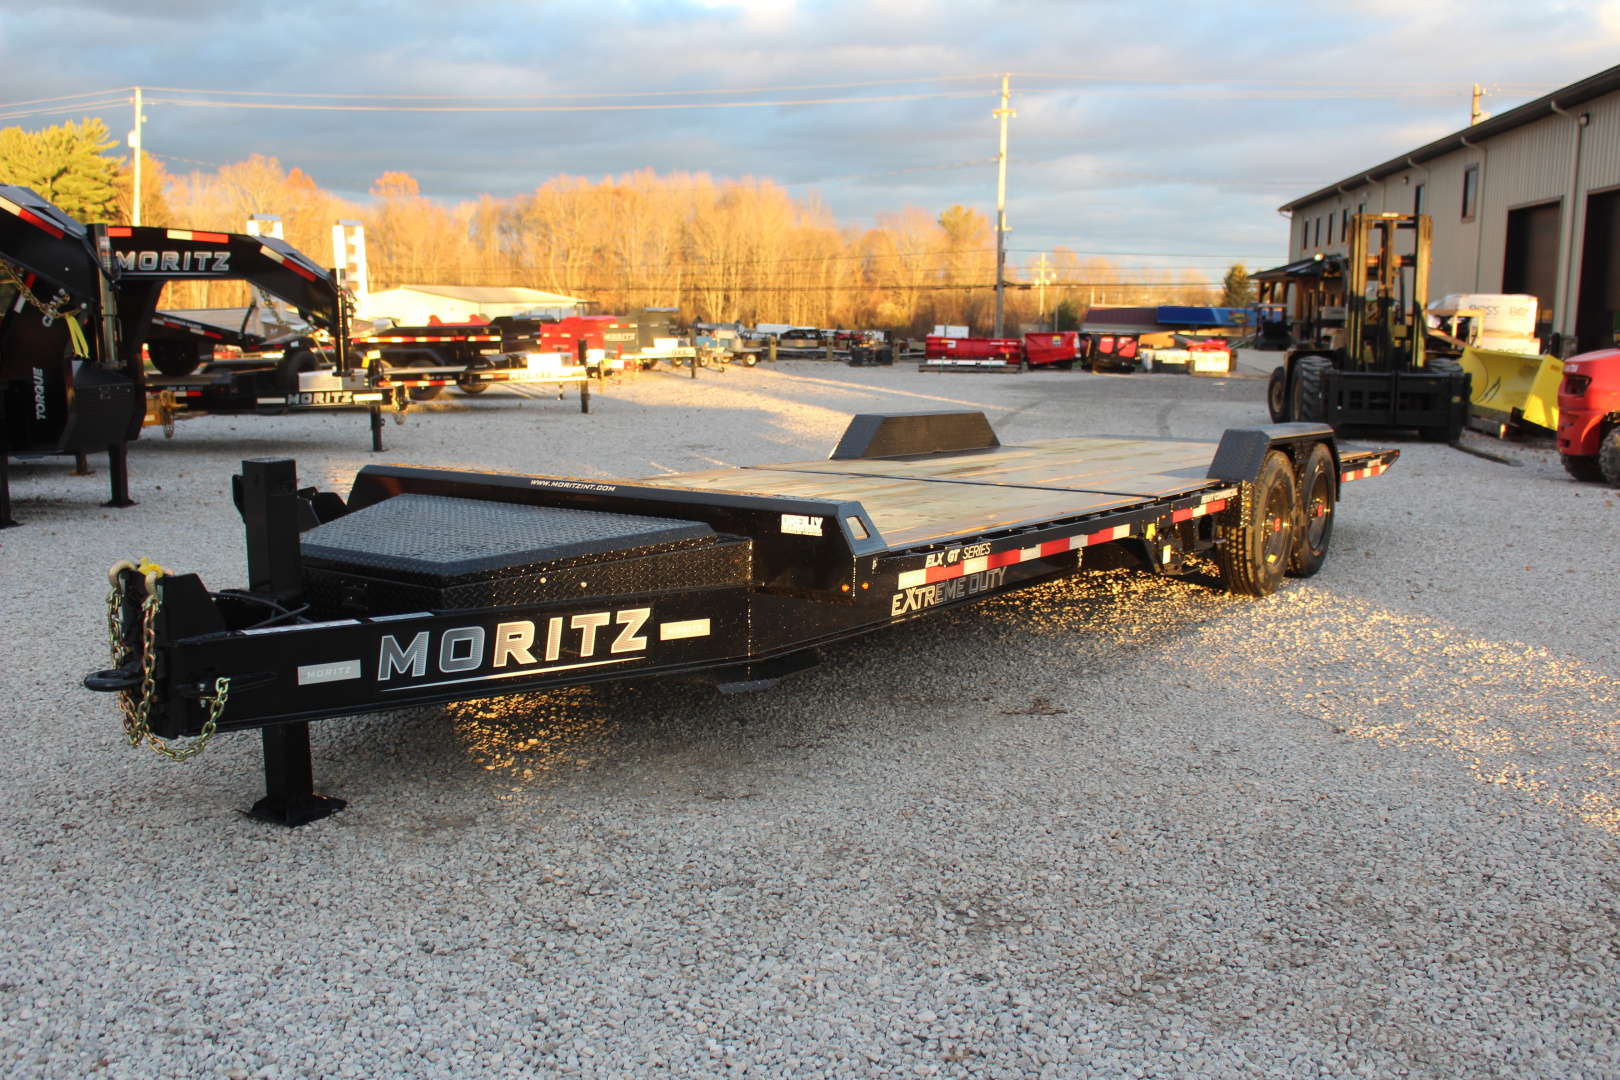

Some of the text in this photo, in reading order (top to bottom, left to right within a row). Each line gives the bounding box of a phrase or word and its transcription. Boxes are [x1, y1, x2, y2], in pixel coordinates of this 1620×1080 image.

[115, 250, 231, 271] MORITZ
[32, 367, 47, 420] TORQUE
[287, 391, 353, 405] MORITZ
[530, 479, 616, 492] WWW.MORITZINT.COM
[925, 542, 992, 568] ELX GT SERIES
[891, 566, 1008, 617] EXTREME DUTY
[667, 624, 704, 636] MORITZ
[377, 607, 652, 682] MORITZ
[306, 665, 353, 679] MORITZ
